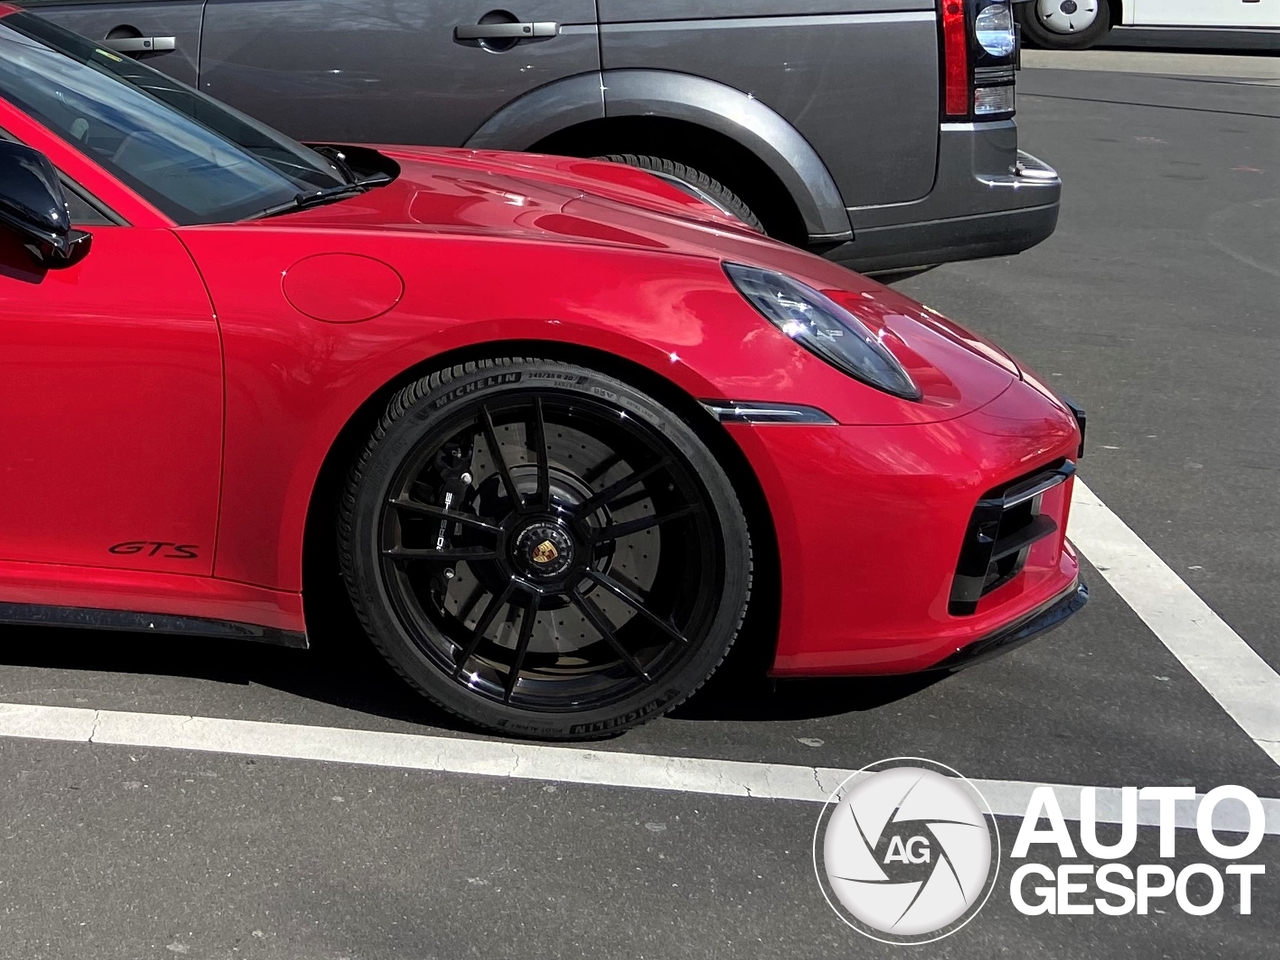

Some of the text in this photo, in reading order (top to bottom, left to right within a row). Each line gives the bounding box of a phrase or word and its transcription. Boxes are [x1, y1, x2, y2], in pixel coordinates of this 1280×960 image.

[435, 373, 516, 408] MICHELIN
[108, 541, 200, 558] GTS
[575, 699, 658, 734] MICHELIN
